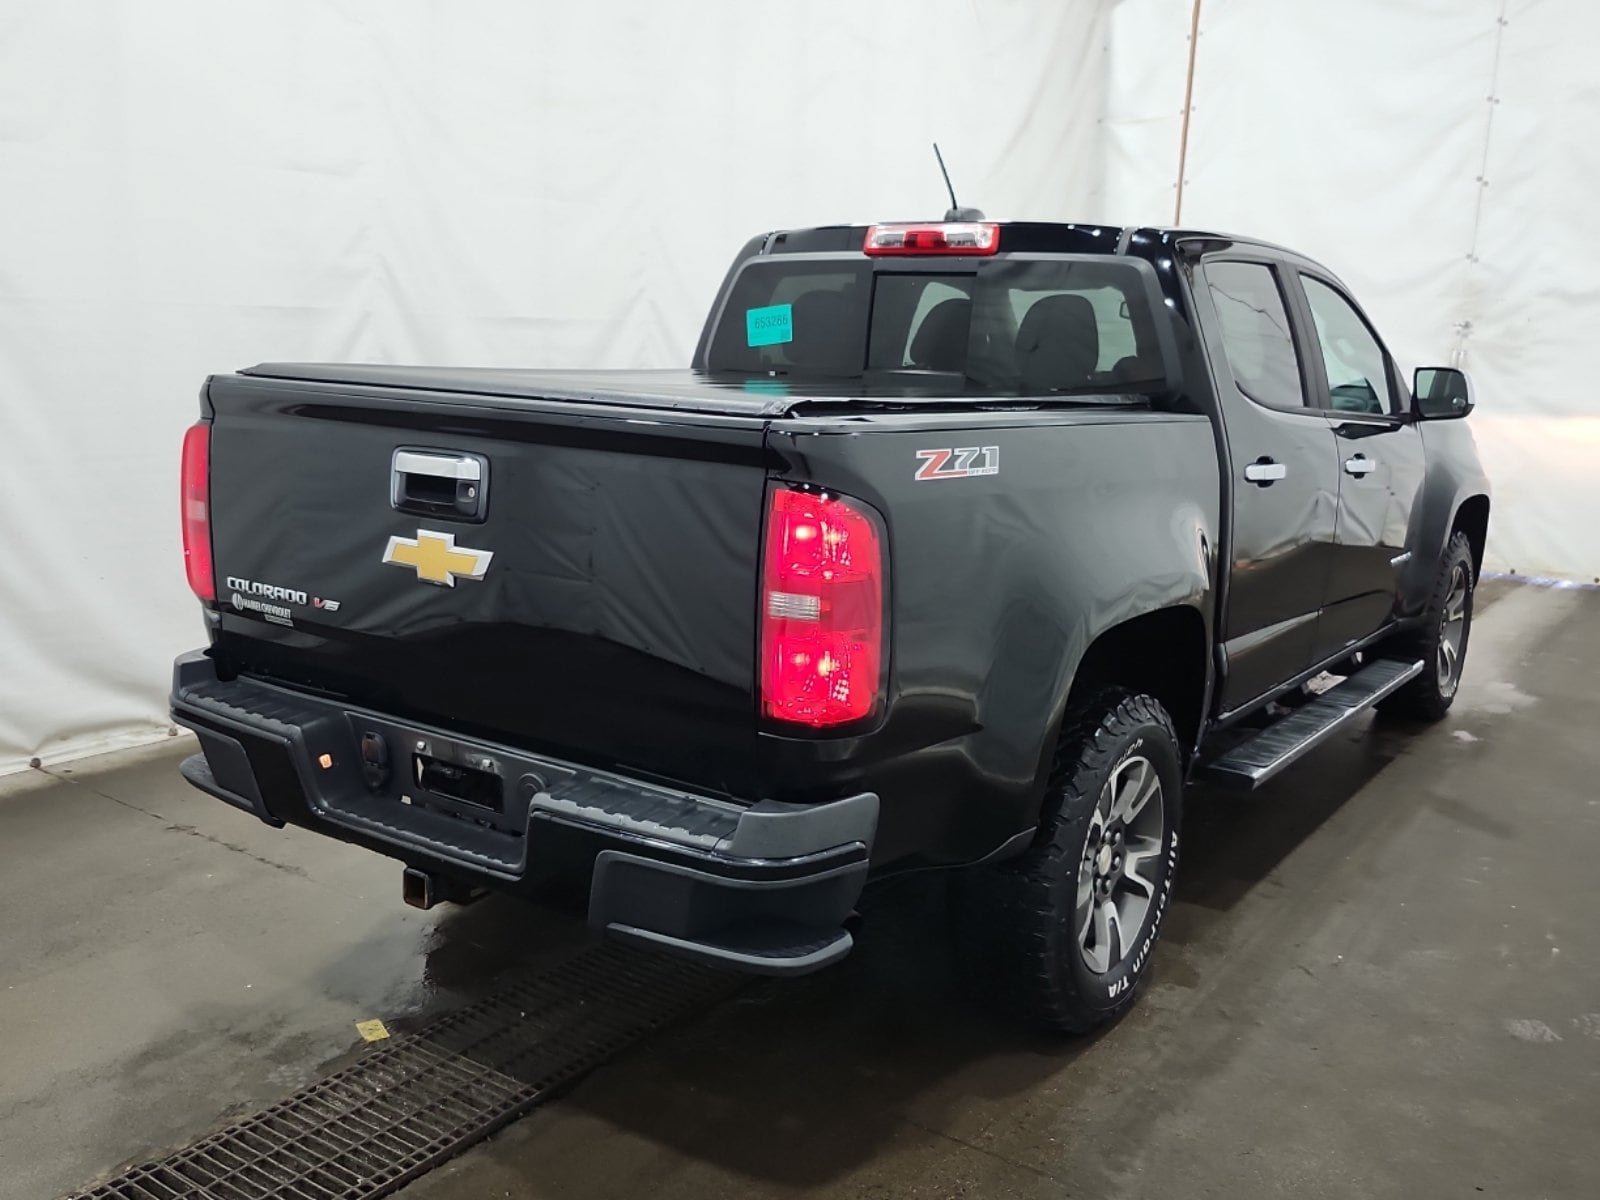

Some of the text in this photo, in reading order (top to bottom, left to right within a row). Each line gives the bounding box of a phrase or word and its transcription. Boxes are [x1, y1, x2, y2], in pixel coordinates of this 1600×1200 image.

[914, 445, 1000, 481] Z71
[226, 575, 341, 612] COLORADO V6
[1107, 979, 1131, 1000] T/A
